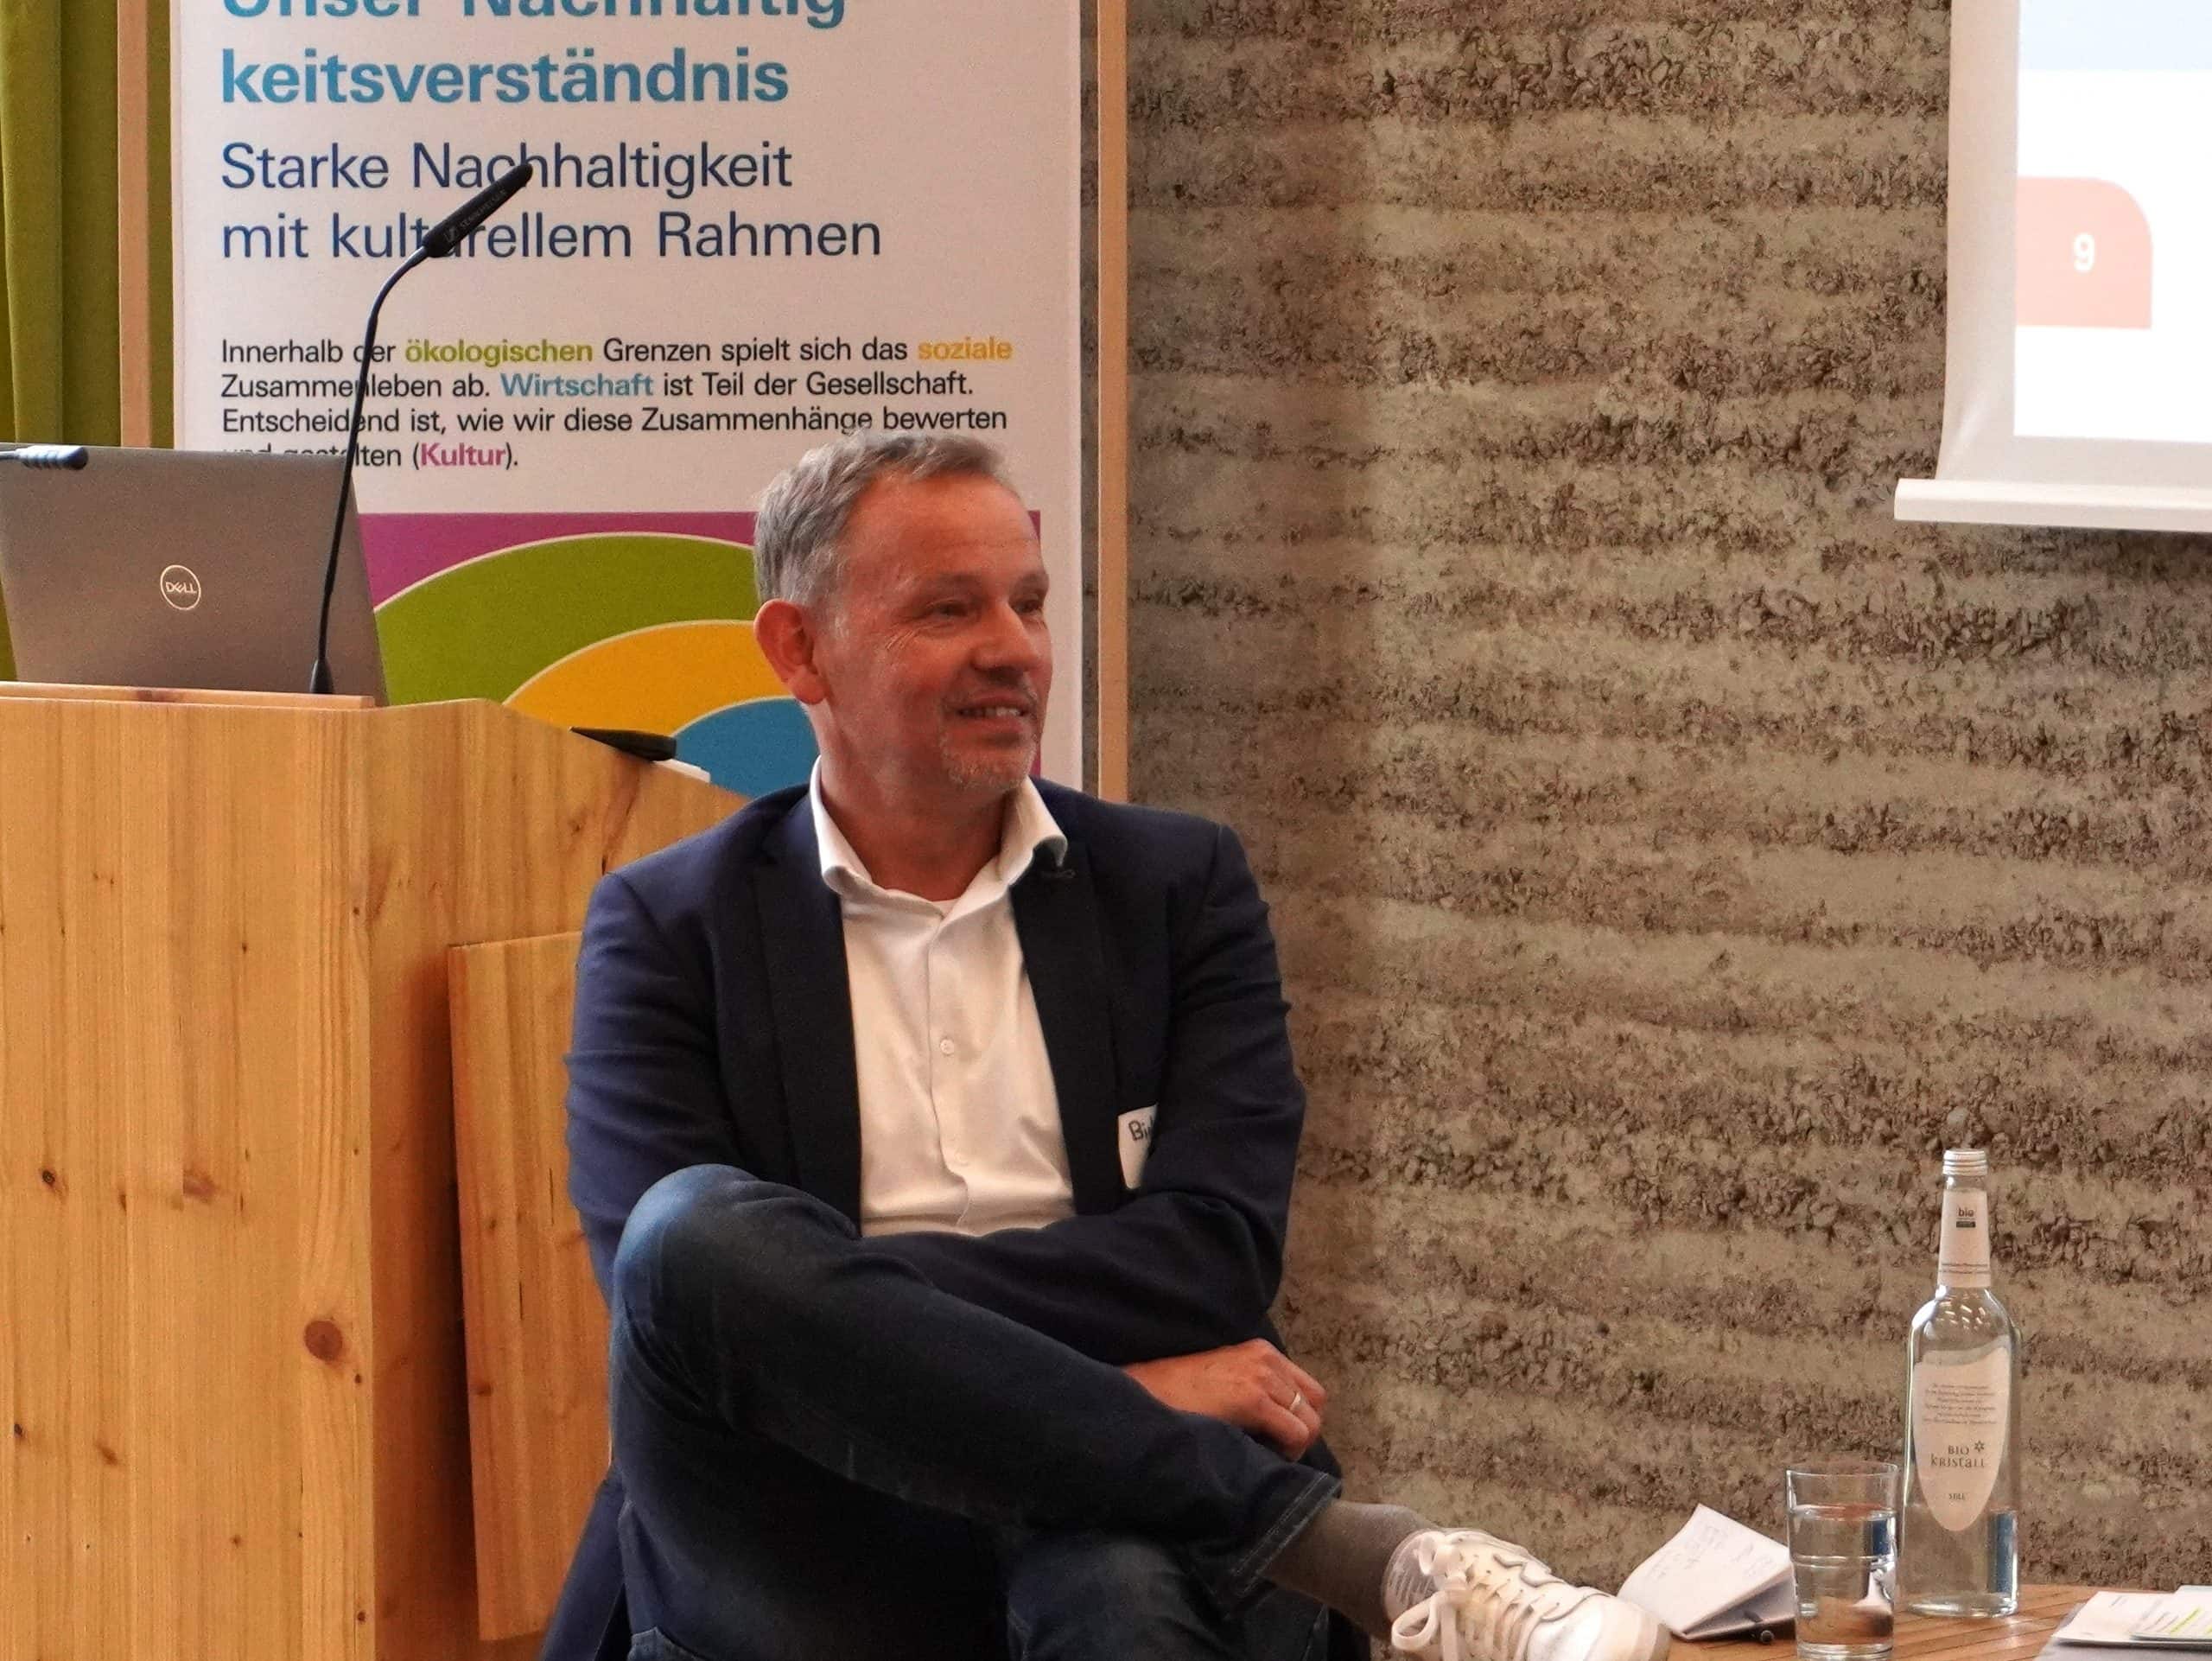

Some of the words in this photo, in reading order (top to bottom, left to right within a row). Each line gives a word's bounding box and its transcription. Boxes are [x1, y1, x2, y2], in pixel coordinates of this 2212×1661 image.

[222, 48, 789, 104] keitsverständnis
[222, 142, 390, 189] Starke
[413, 141, 793, 200] Nachhaltigkeit
[224, 213, 309, 258] mit
[333, 212, 632, 258] kultrellem
[659, 211, 880, 258] Rahmen
[2073, 232, 2096, 273] 9
[222, 340, 344, 364] Innerhalb
[406, 340, 594, 369] ökologischen
[603, 338, 711, 363] Grenzen
[721, 337, 791, 367] spielt
[800, 337, 852, 361] sich
[862, 336, 908, 361] das
[918, 336, 1014, 361] soziale
[453, 374, 491, 398] ab.
[501, 373, 654, 398] Wirtschaft
[664, 373, 694, 398] ist
[702, 372, 745, 397] Teil
[754, 372, 798, 397] der
[806, 371, 974, 397] Gesellschaft.
[223, 408, 401, 433] Entscheidend
[410, 408, 447, 436] ist,
[456, 408, 505, 432] wie
[513, 408, 556, 432] wir
[563, 407, 633, 432] diese
[642, 406, 874, 436] Zusammenhänge
[883, 405, 1008, 430] bewerten
[412, 442, 519, 472] (Kultur).
[165, 582, 197, 594] DELL
[1948, 1445, 1969, 1454] BIO
